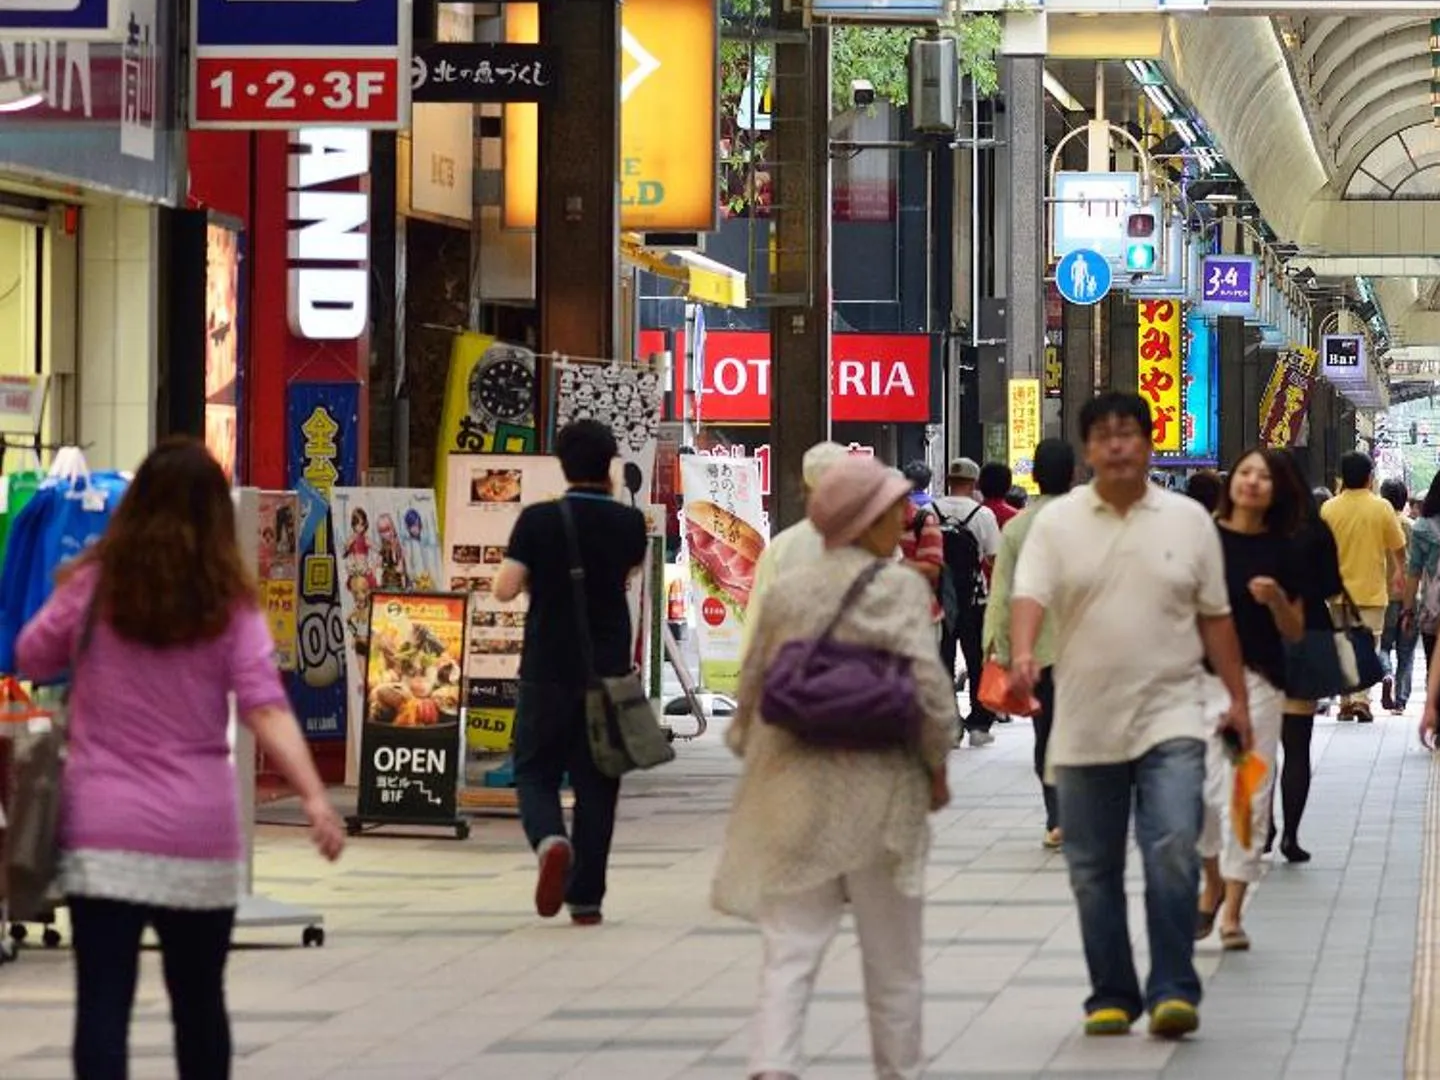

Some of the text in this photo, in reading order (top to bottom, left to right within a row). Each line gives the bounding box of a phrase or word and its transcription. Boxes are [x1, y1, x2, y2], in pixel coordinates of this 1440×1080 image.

[432, 59, 551, 87] 北の魚づくし
[373, 746, 446, 775] OPEN
